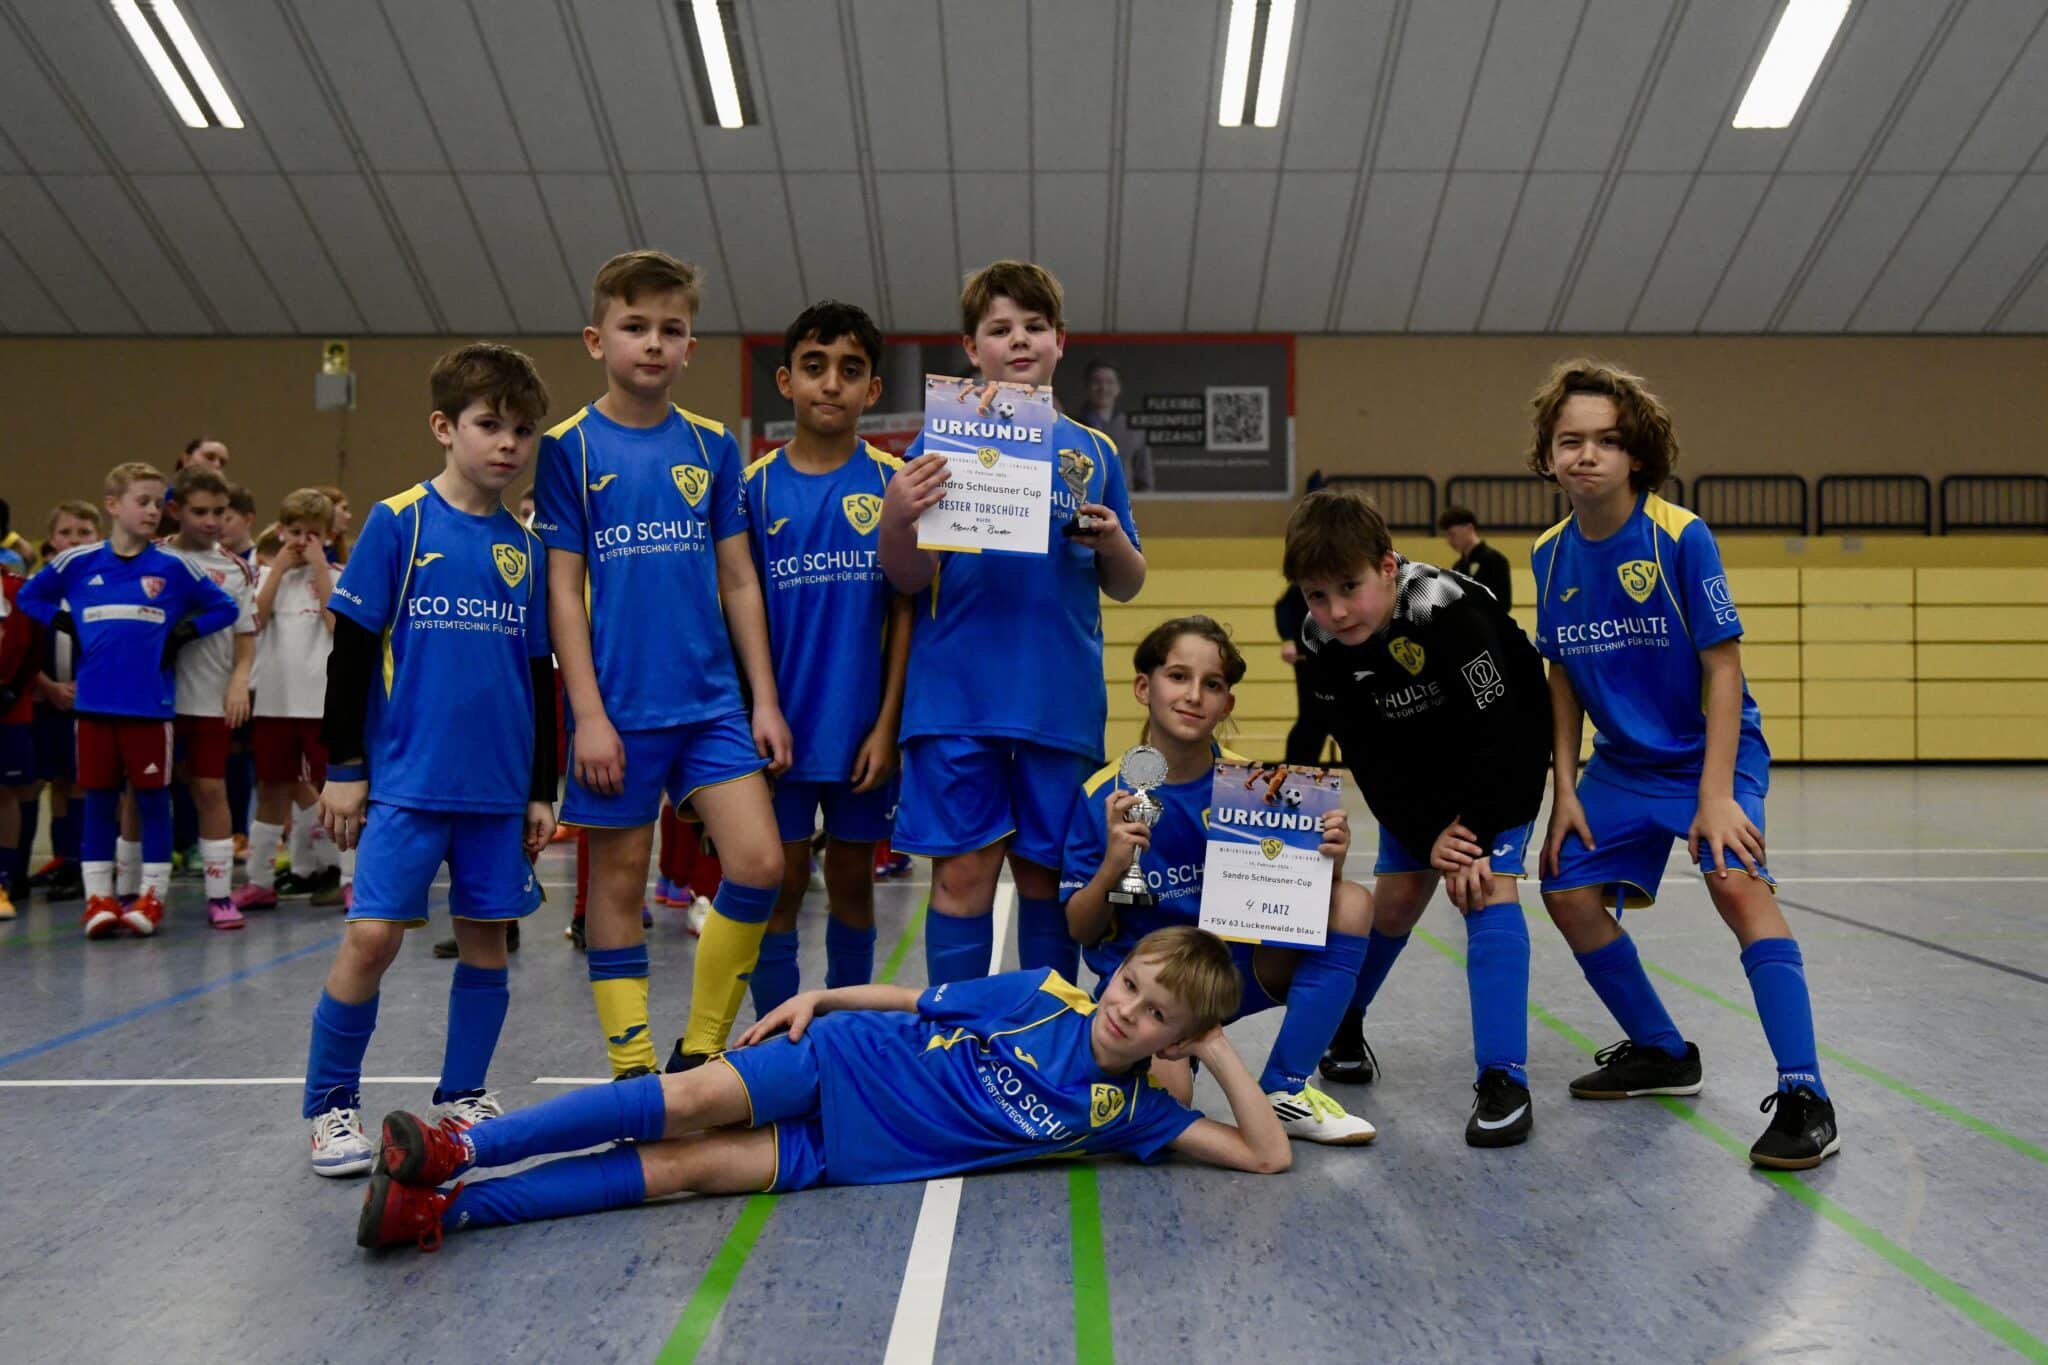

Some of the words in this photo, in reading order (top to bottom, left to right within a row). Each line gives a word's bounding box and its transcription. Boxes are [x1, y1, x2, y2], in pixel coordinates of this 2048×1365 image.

[932, 418, 1043, 444] URKUNDE
[966, 481, 1021, 495] Schleusner
[1023, 487, 1042, 499] Cup
[939, 500, 971, 512] BESTER
[974, 502, 1031, 518] TORSCHÜTZE
[594, 524, 632, 549] ECO
[674, 541, 691, 552] FÜR
[802, 550, 884, 572] SCHULT
[408, 596, 450, 617] ECO
[414, 619, 490, 632] SYSTEMTECHNIK
[1588, 616, 1668, 640] SCHULTE
[1475, 683, 1505, 710] ECO
[1218, 807, 1325, 833] URKUNDE
[1222, 870, 1250, 881] Sandro
[1251, 873, 1313, 888] Schleusner-Cup
[1245, 899, 1255, 910] 4
[1262, 902, 1290, 916] PLATZ
[1211, 917, 1227, 926] FSV
[1228, 919, 1239, 927] 63
[1240, 920, 1295, 933] Luckenwalde
[1296, 927, 1315, 935] blau
[982, 1074, 1040, 1139] SYSTEMTECHNIK
